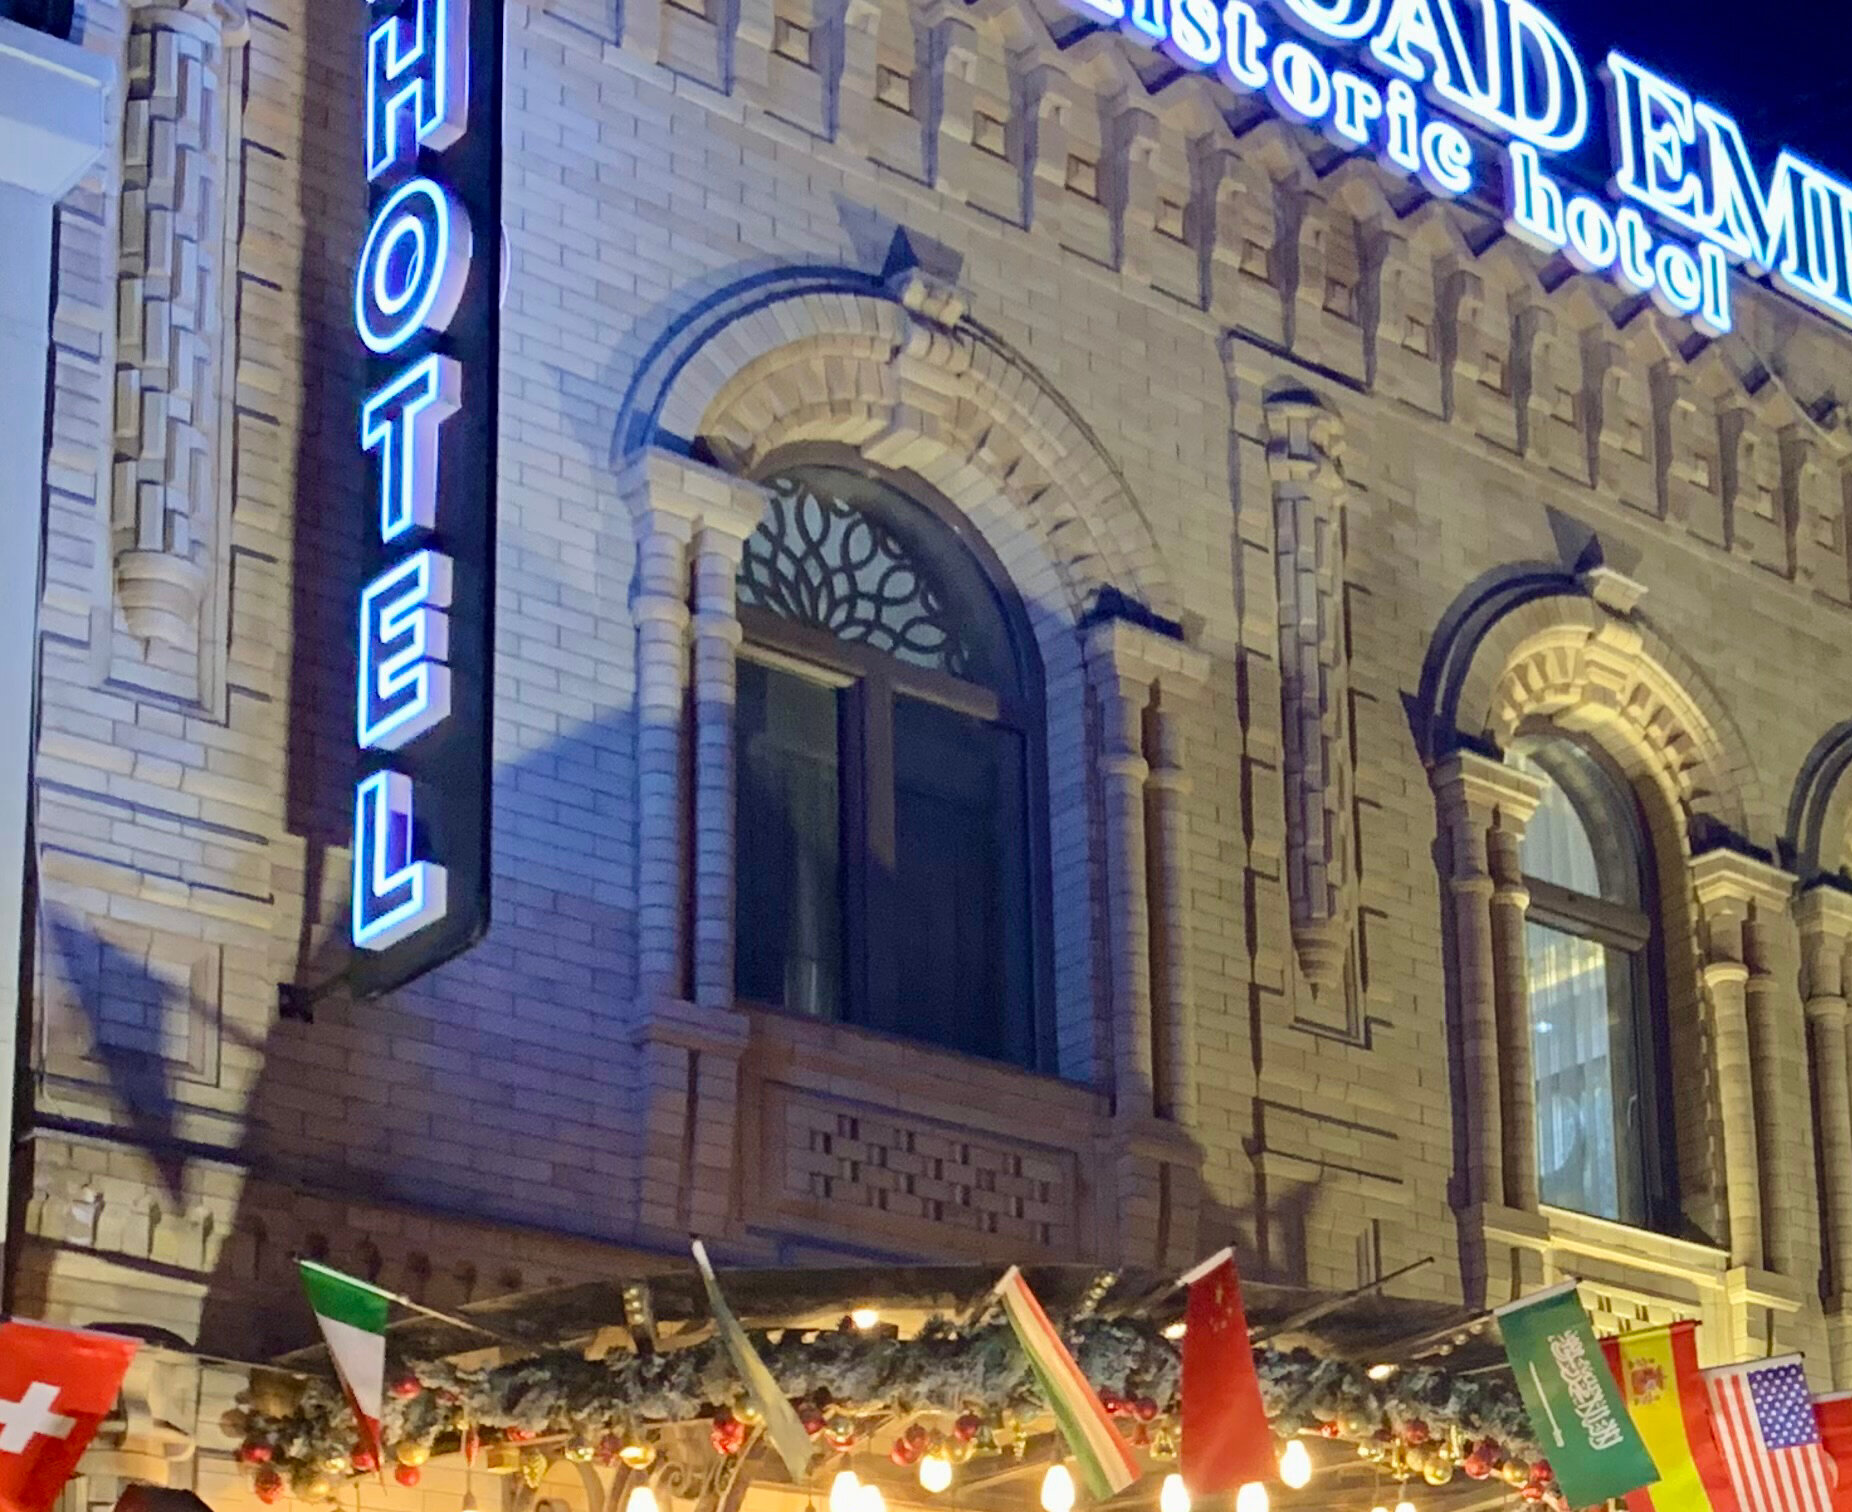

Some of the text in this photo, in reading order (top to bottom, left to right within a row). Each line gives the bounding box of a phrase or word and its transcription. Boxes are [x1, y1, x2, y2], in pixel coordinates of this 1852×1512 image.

[352, 0, 466, 950] HOTEL
[1064, 0, 1731, 334] storic hotel
